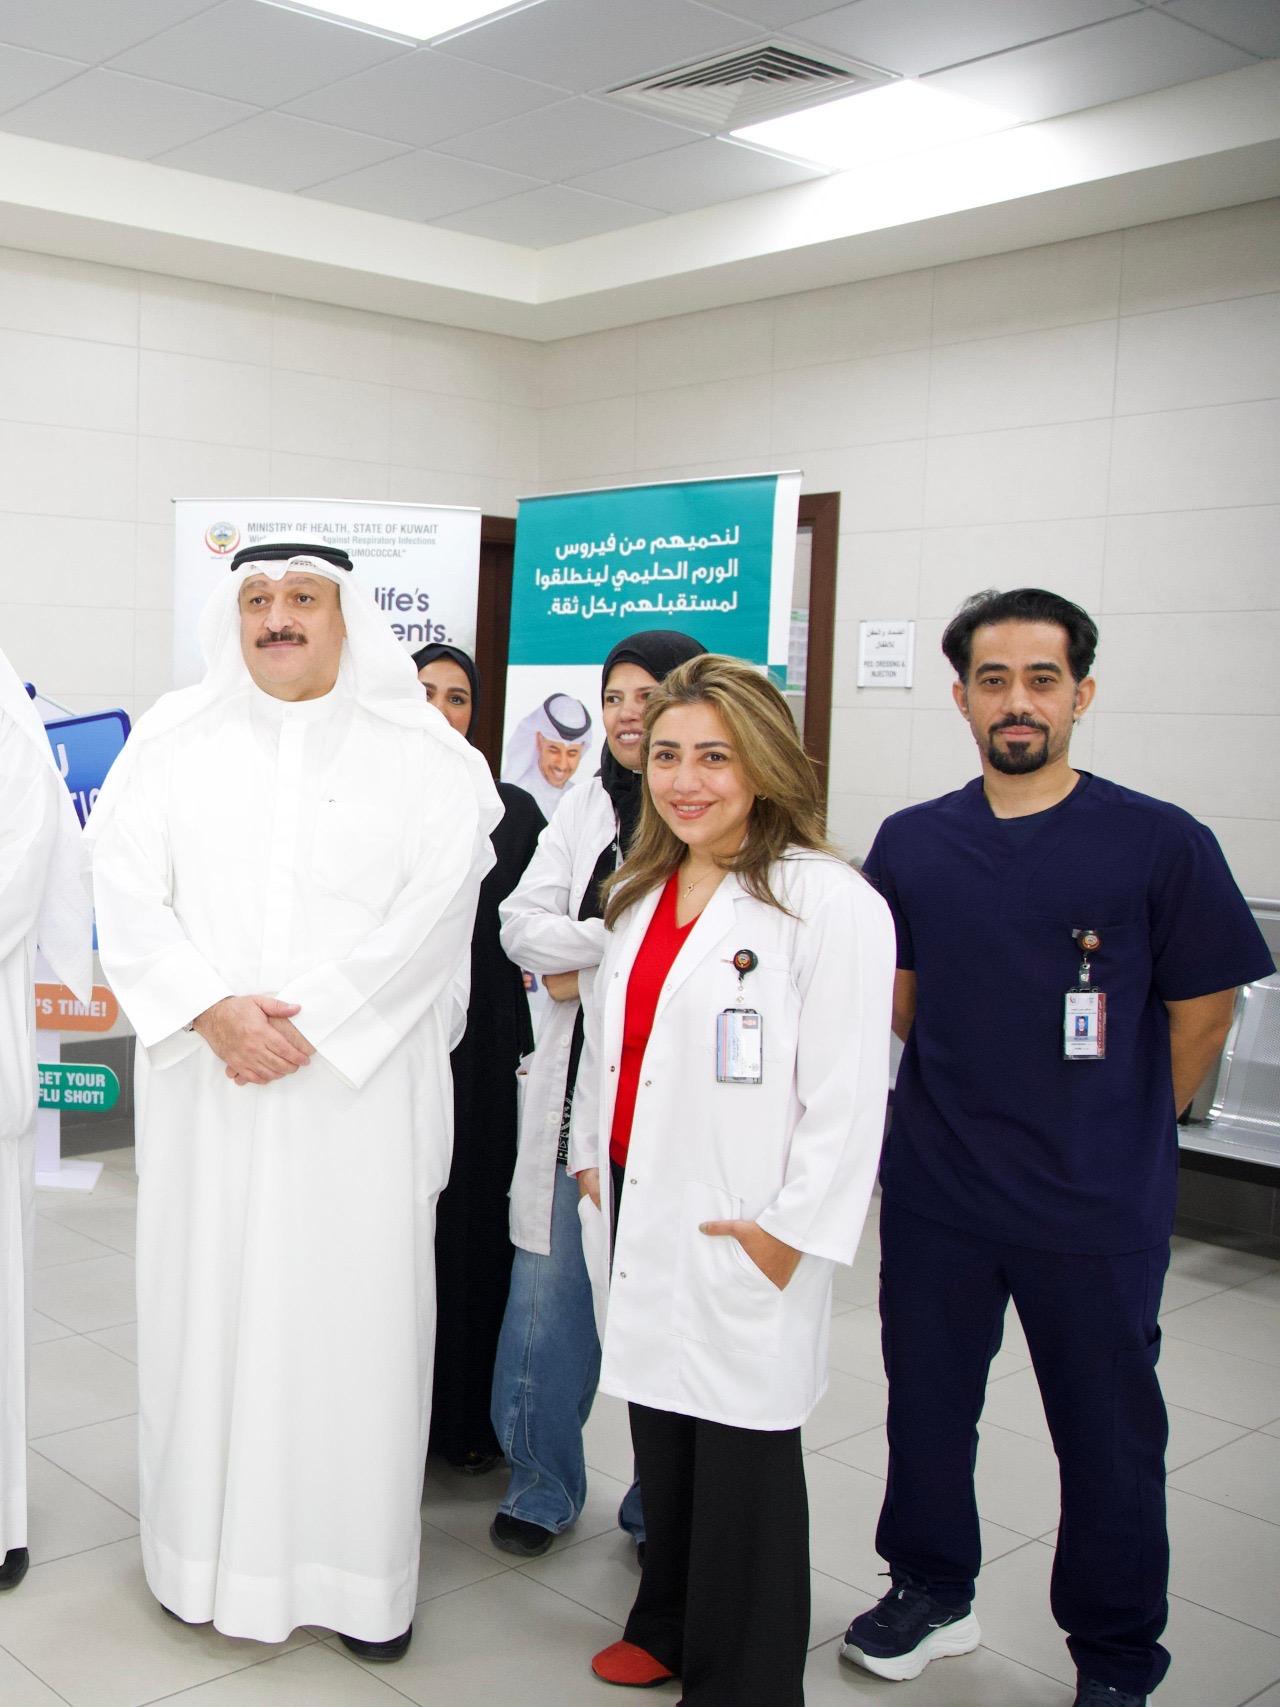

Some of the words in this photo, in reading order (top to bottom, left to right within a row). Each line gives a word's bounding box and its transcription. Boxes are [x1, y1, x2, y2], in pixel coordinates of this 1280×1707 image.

[247, 522, 293, 534] MINISTRY
[295, 523, 308, 533] OF
[353, 523, 382, 534] STATE
[385, 524, 399, 534] OF
[400, 524, 438, 535] KUWAIT
[352, 535, 397, 546] Respiratory
[398, 536, 436, 546] Infections
[650, 525, 740, 555] لنحميهم
[349, 548, 407, 559] EUMOCOCCAL"
[555, 533, 617, 560] فيروس
[619, 536, 646, 556] من
[535, 564, 609, 591] لينطلقوا
[611, 560, 688, 591] الحليمي
[691, 558, 739, 584] الورم
[375, 586, 430, 612] life's
[547, 595, 579, 615] ثقة.
[581, 595, 617, 619] بكل
[620, 591, 738, 617] لمستقبلهم
[391, 617, 453, 643] ents.
[36, 998, 53, 1015] 'S
[57, 999, 108, 1017] TIME!
[38, 1070, 62, 1085] GET
[66, 1072, 107, 1087] YOUR
[64, 1089, 105, 1105] SHOT!
